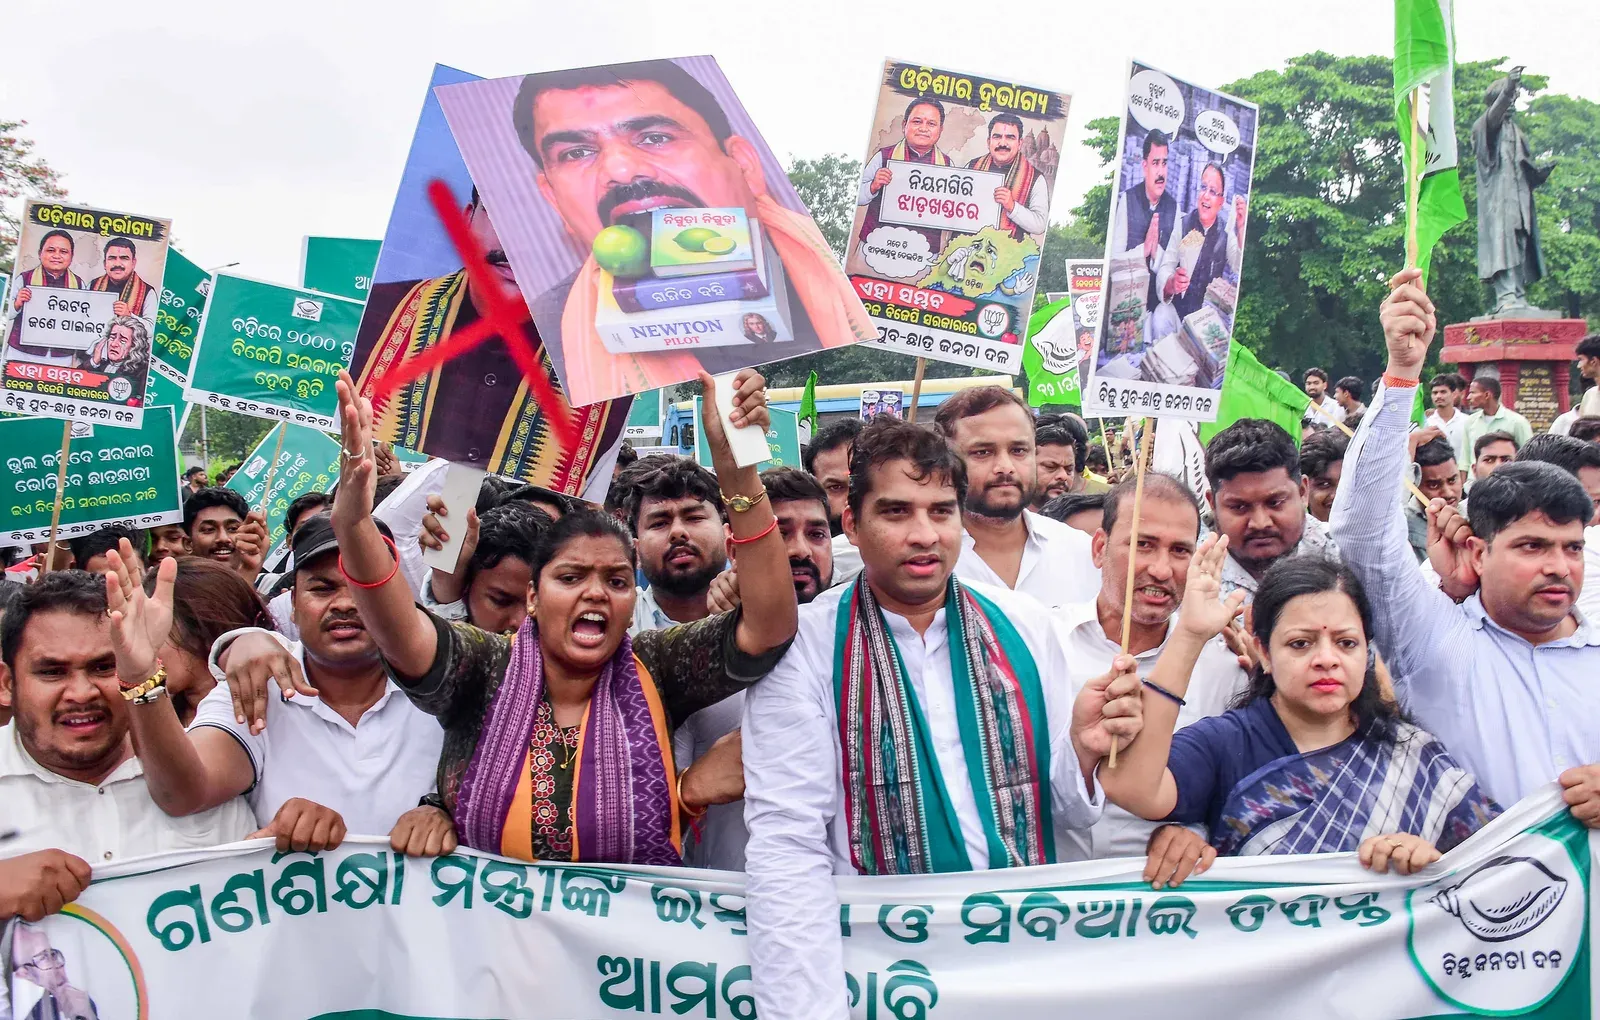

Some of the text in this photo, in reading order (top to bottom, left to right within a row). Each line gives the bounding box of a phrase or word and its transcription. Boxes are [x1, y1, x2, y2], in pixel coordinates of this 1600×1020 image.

[900, 66, 1049, 114] ଓଡ଼ିଶାର ଦୁର୍ଭାଗ୍ୟ
[909, 169, 974, 196] ନିୟମଗିରି
[37, 205, 154, 238] ଓଡ଼ିଶାର ଦୁର୍ଭାଗ୍ୟ
[897, 194, 980, 221] ଝାଡ଼ଖଣ୍ଡରେ
[859, 281, 944, 309] ଏହା ସମ୍ଭବ
[28, 316, 56, 330] ଜଣେ
[629, 320, 724, 339] NEWTON
[885, 303, 920, 324] ବିଜେପି
[922, 313, 978, 335] ସରକାରରେ
[231, 316, 282, 342] ବହିରେ
[287, 330, 336, 351] ୨୦୦୦
[664, 336, 700, 346] PILOT
[231, 338, 282, 365] ବିଜେପି
[939, 333, 980, 358] ଜନତା
[984, 347, 1009, 364] ଦଳ
[15, 364, 84, 384] ଏହା ସମ୍ଭବ
[254, 371, 324, 399] ହେବ ଛୁଟି
[5, 379, 110, 401] କେବଳ ବିଜେପି ସରକାରରେ
[1099, 381, 1117, 407] ବିଜୁ
[1120, 388, 1162, 410] ଯୁବ-ଛାତ୍ର
[1165, 393, 1193, 411] ଜନତା
[1196, 397, 1212, 412] ଦଳ
[6, 393, 26, 411] ବିଜୁ
[29, 398, 76, 417] ଯୁବ-ଛାତ୍ର
[80, 405, 112, 420] ଜନତା
[115, 410, 134, 423] ଦଳ
[208, 393, 333, 428] ବିଜୁ ଯୁବ-ଛାତ୍ର ଜନତା
[6, 455, 37, 474] ଭୁଲ
[98, 444, 154, 462] ସରକାର
[78, 493, 131, 509] ସରକାରର
[135, 487, 157, 500] ନୀତି
[141, 515, 163, 523] ଦଳ
[147, 851, 405, 951] ଗଣଶିକ୍ଷା
[877, 904, 934, 944] ଓ
[1442, 950, 1562, 979] ବିଜୁ ଜନତା ଦଳ
